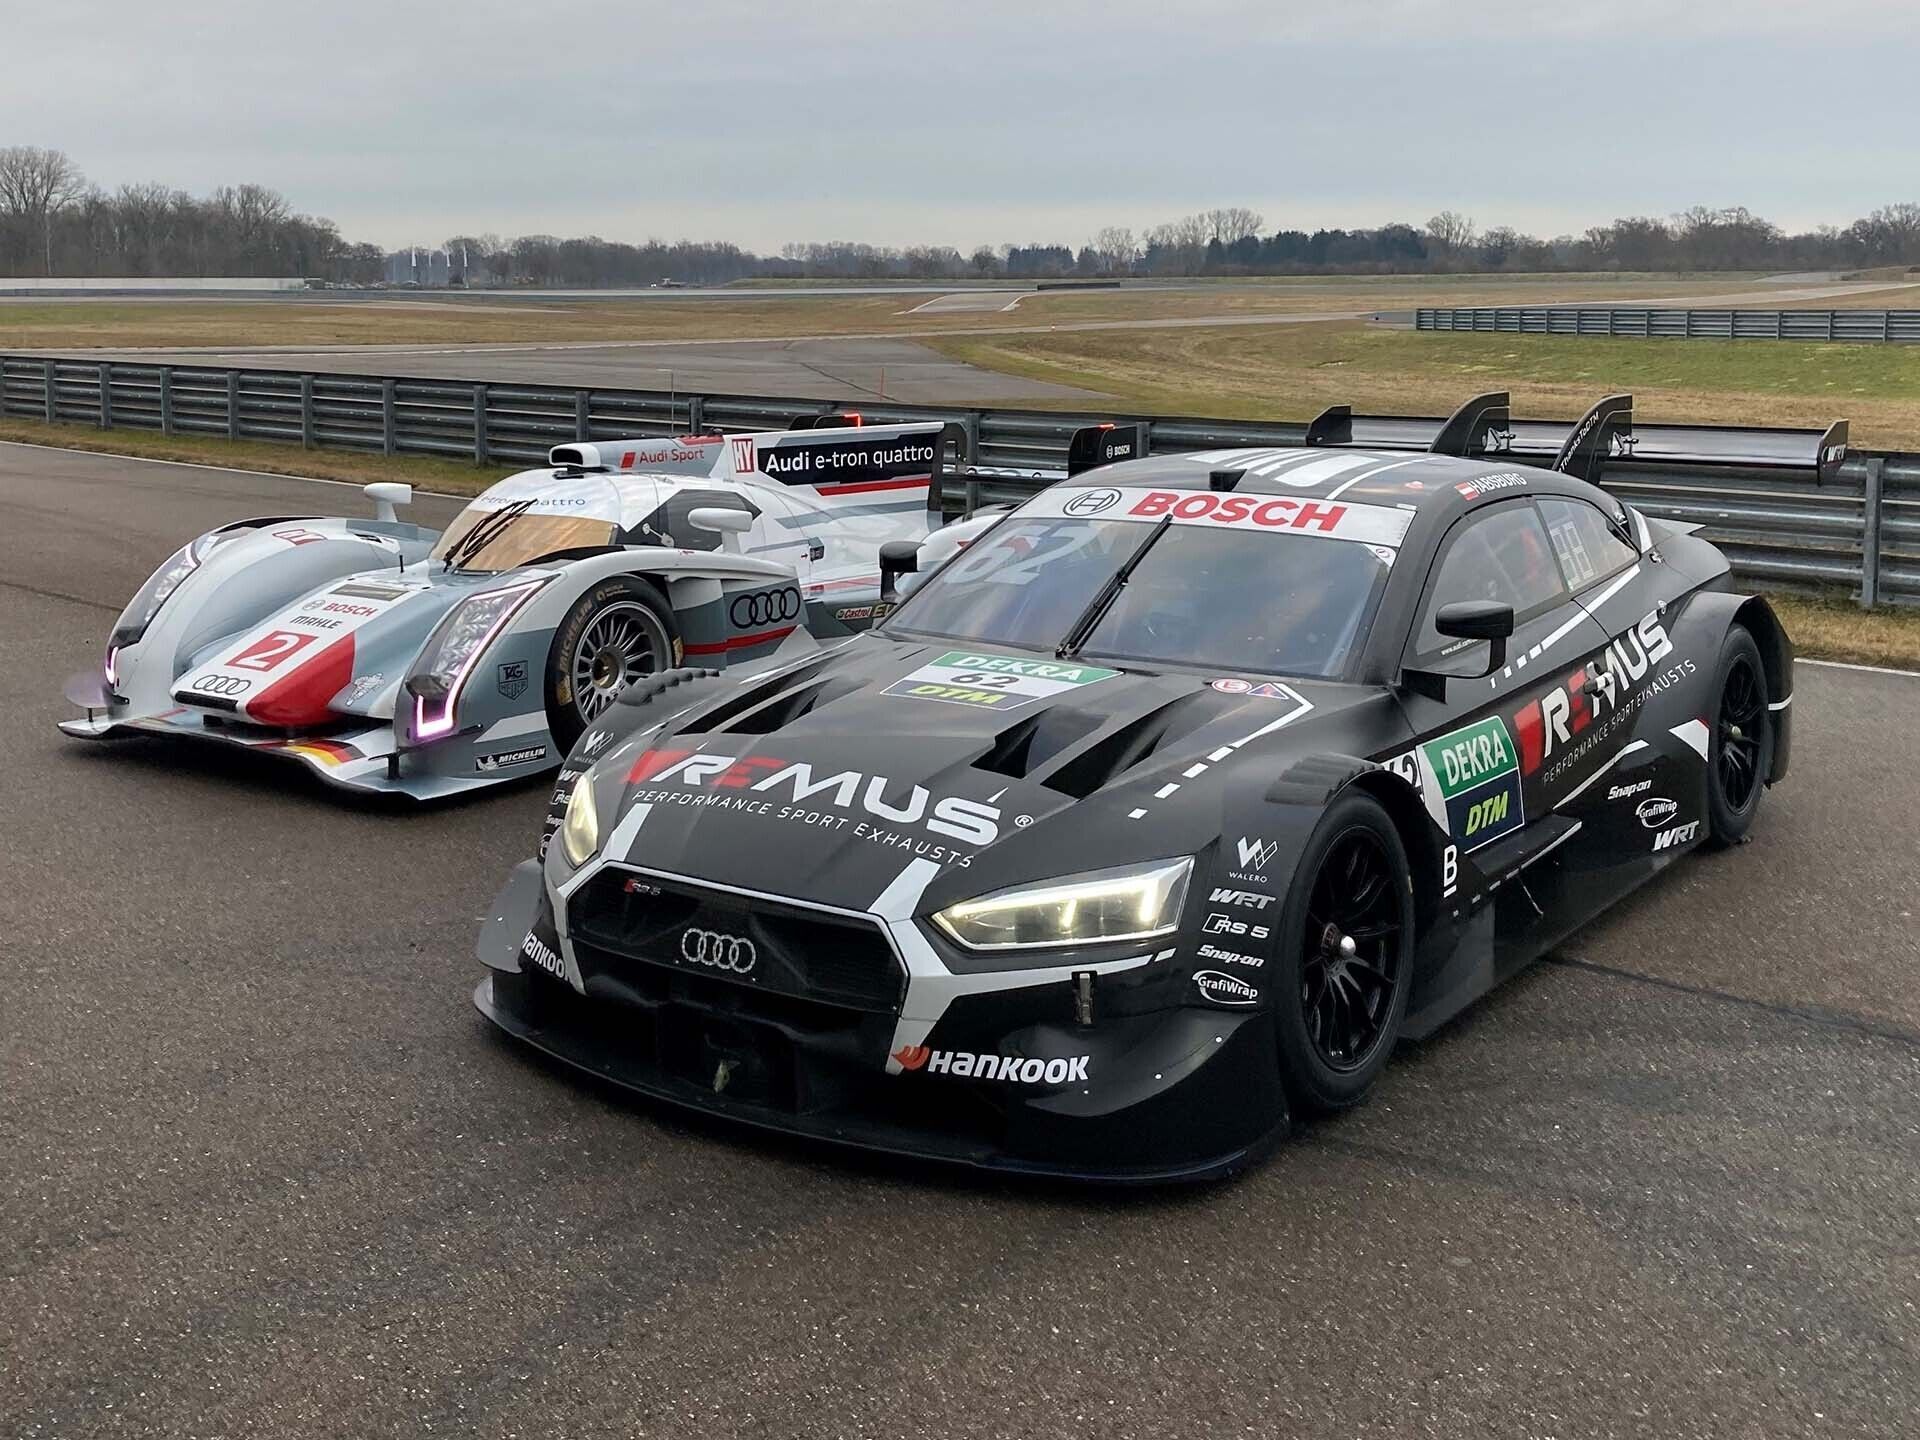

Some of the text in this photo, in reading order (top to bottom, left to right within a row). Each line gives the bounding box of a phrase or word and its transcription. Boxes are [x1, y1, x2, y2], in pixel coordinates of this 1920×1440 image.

[640, 449, 704, 463] Audi Sport
[733, 440, 752, 473] HY
[765, 446, 934, 473] Audi e-tron quattro
[1114, 444, 1130, 456] BOSCH
[1468, 473, 1528, 495] HABSBURG
[1128, 492, 1348, 532] BOSCH
[944, 525, 1099, 585] 62
[323, 602, 378, 617] BOSCH
[844, 607, 871, 619] Castrol
[290, 615, 343, 630] MAHLE
[235, 634, 300, 668] 2
[503, 664, 524, 680] TAG
[950, 672, 1020, 689] 62
[951, 656, 1084, 682] DEKRA
[910, 684, 1008, 704] DTM
[1541, 609, 1674, 759] REMUS
[1543, 722, 1609, 786] PERFORMANCE
[1611, 699, 1635, 731] SPORT
[498, 748, 545, 763] MICHELIN
[1441, 729, 1508, 787] DEKRA
[650, 754, 1001, 846] REMUS
[1608, 779, 1652, 800] Snap-on
[1465, 791, 1509, 837] DTM
[1639, 801, 1678, 818] GrafiWrap
[632, 789, 974, 868] PERFORMANCE SPORT EXHAUSTS
[1652, 820, 1700, 852] WRT
[1229, 871, 1267, 883] WALERO
[1444, 844, 1458, 888] B
[1209, 887, 1276, 910] WRT
[1250, 925, 1270, 939] 5
[1197, 944, 1264, 968] Snap-on
[1198, 976, 1258, 999] GrafiWrap
